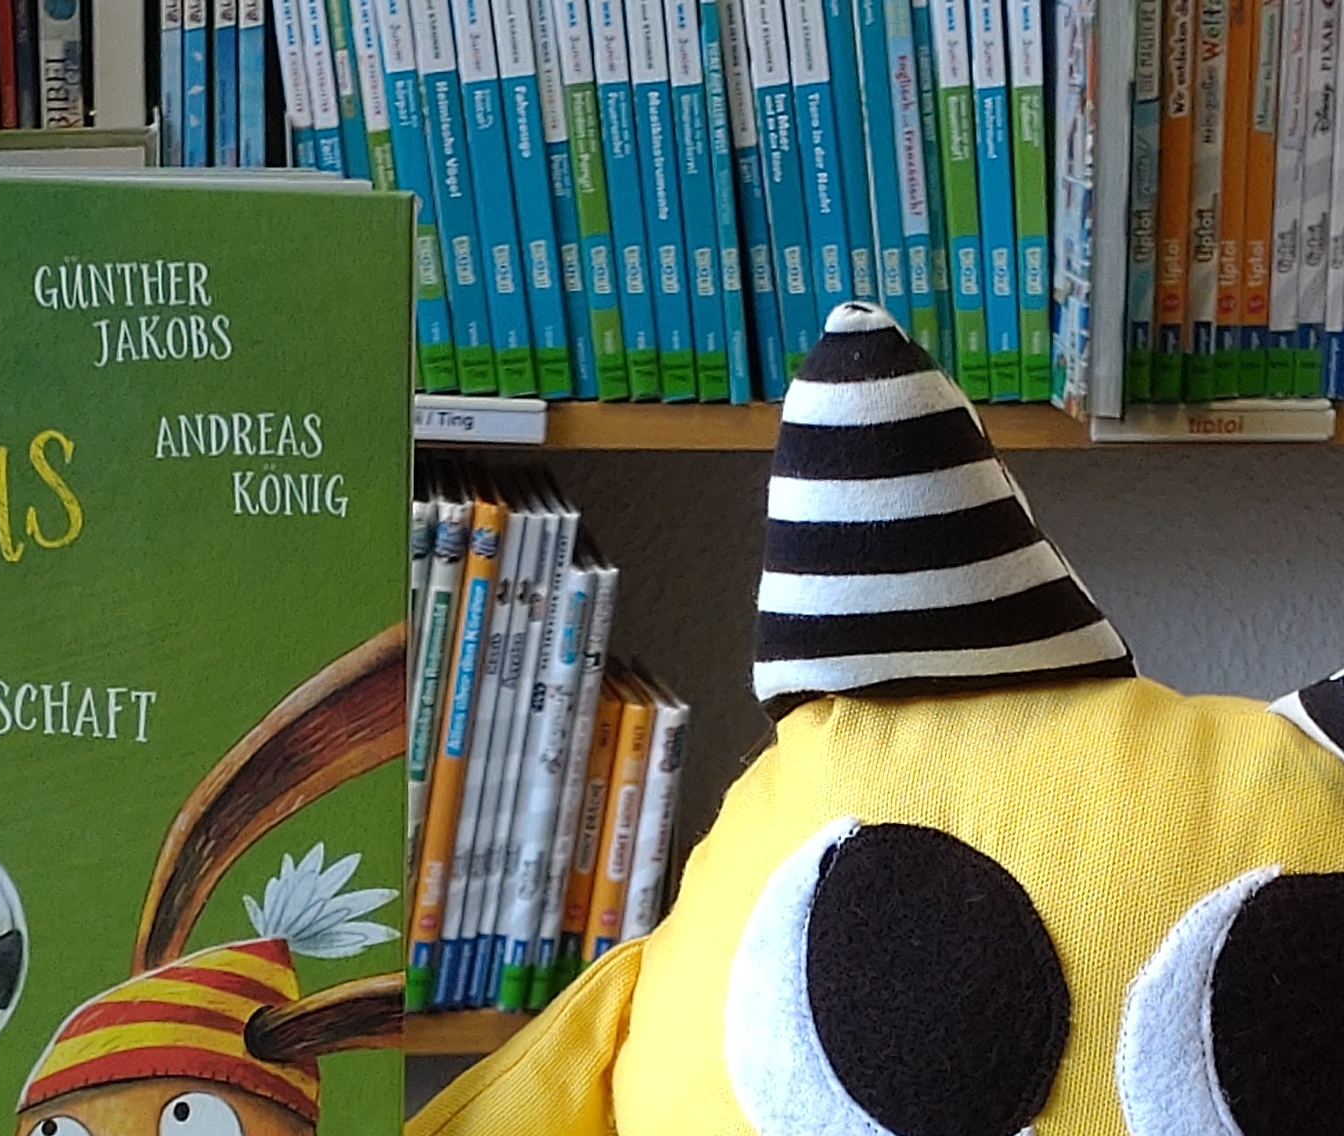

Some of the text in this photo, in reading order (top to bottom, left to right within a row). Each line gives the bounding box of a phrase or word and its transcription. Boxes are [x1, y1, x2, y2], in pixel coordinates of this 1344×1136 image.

[1321, 17, 1334, 71] PIXAR
[33, 255, 212, 310] GÜNTHER
[92, 313, 233, 368] JAKOBS
[155, 412, 324, 459] ANDREAS
[437, 411, 476, 430] Ting
[231, 463, 349, 520] KÖNIG
